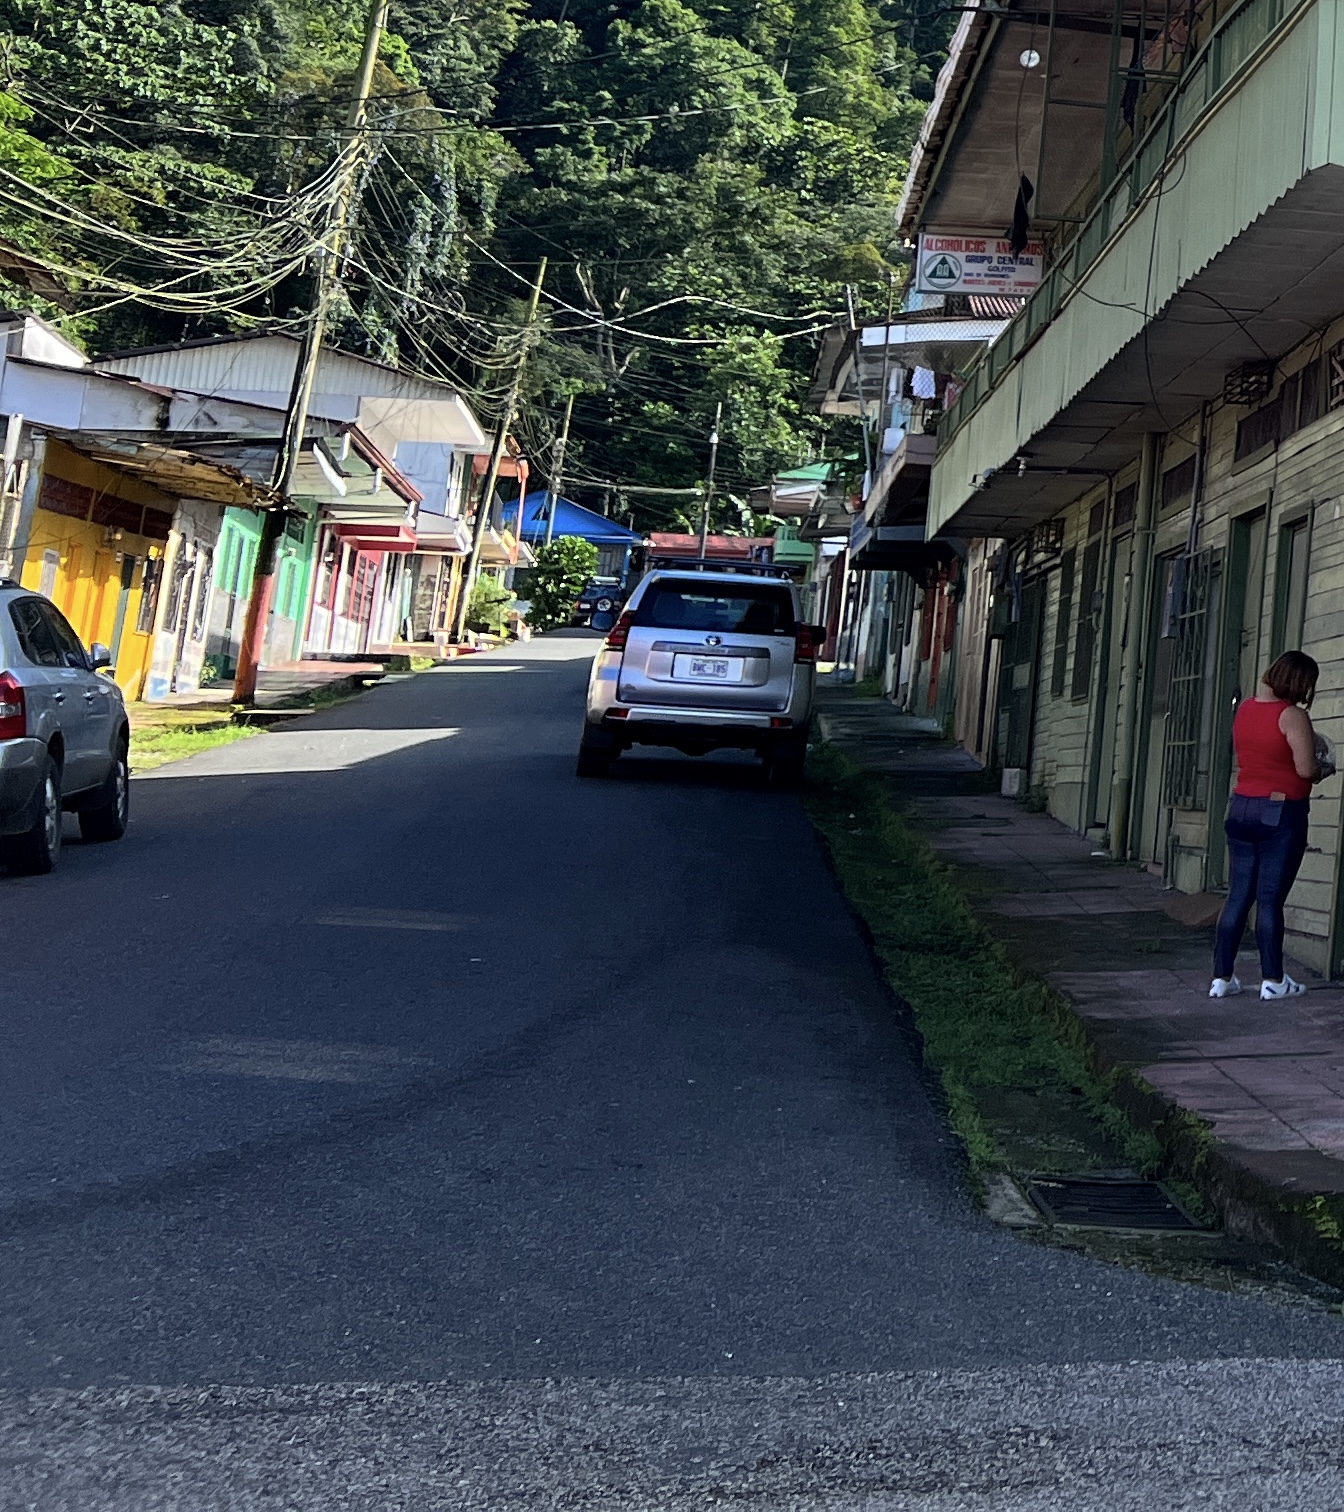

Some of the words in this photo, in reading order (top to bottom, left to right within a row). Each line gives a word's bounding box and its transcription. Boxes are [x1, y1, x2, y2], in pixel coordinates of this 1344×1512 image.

[924, 238, 987, 253] ALCOHOLICOS
[965, 255, 993, 264] GRUPO
[936, 264, 949, 277] AA
